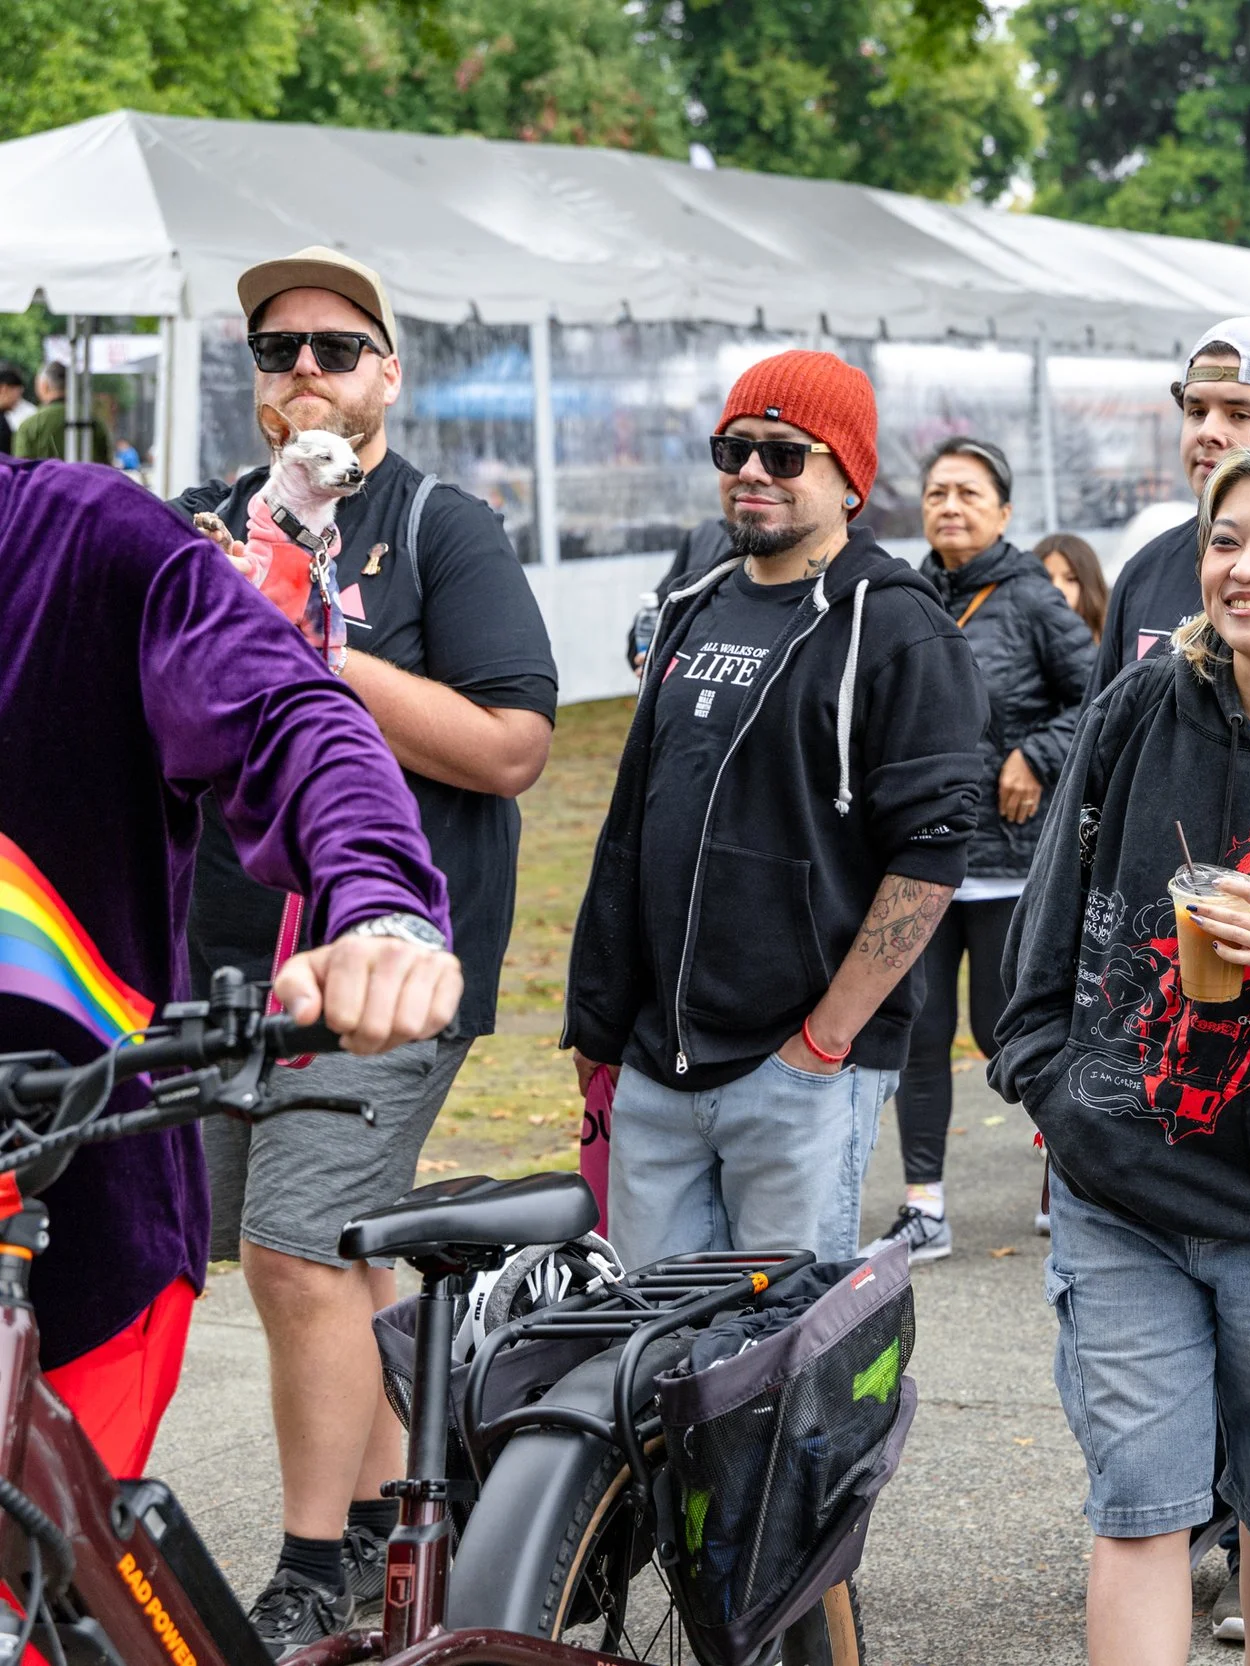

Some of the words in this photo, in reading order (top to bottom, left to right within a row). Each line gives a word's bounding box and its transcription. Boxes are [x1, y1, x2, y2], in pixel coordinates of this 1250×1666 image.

[699, 642, 718, 652] ALL
[719, 643, 752, 655] WALKS
[752, 648, 770, 658] OF
[683, 652, 762, 687] LIFE
[1090, 1071, 1098, 1079] I
[1100, 1072, 1112, 1083] AM
[1114, 1076, 1142, 1090] CORPSE
[116, 1552, 153, 1604] RAD
